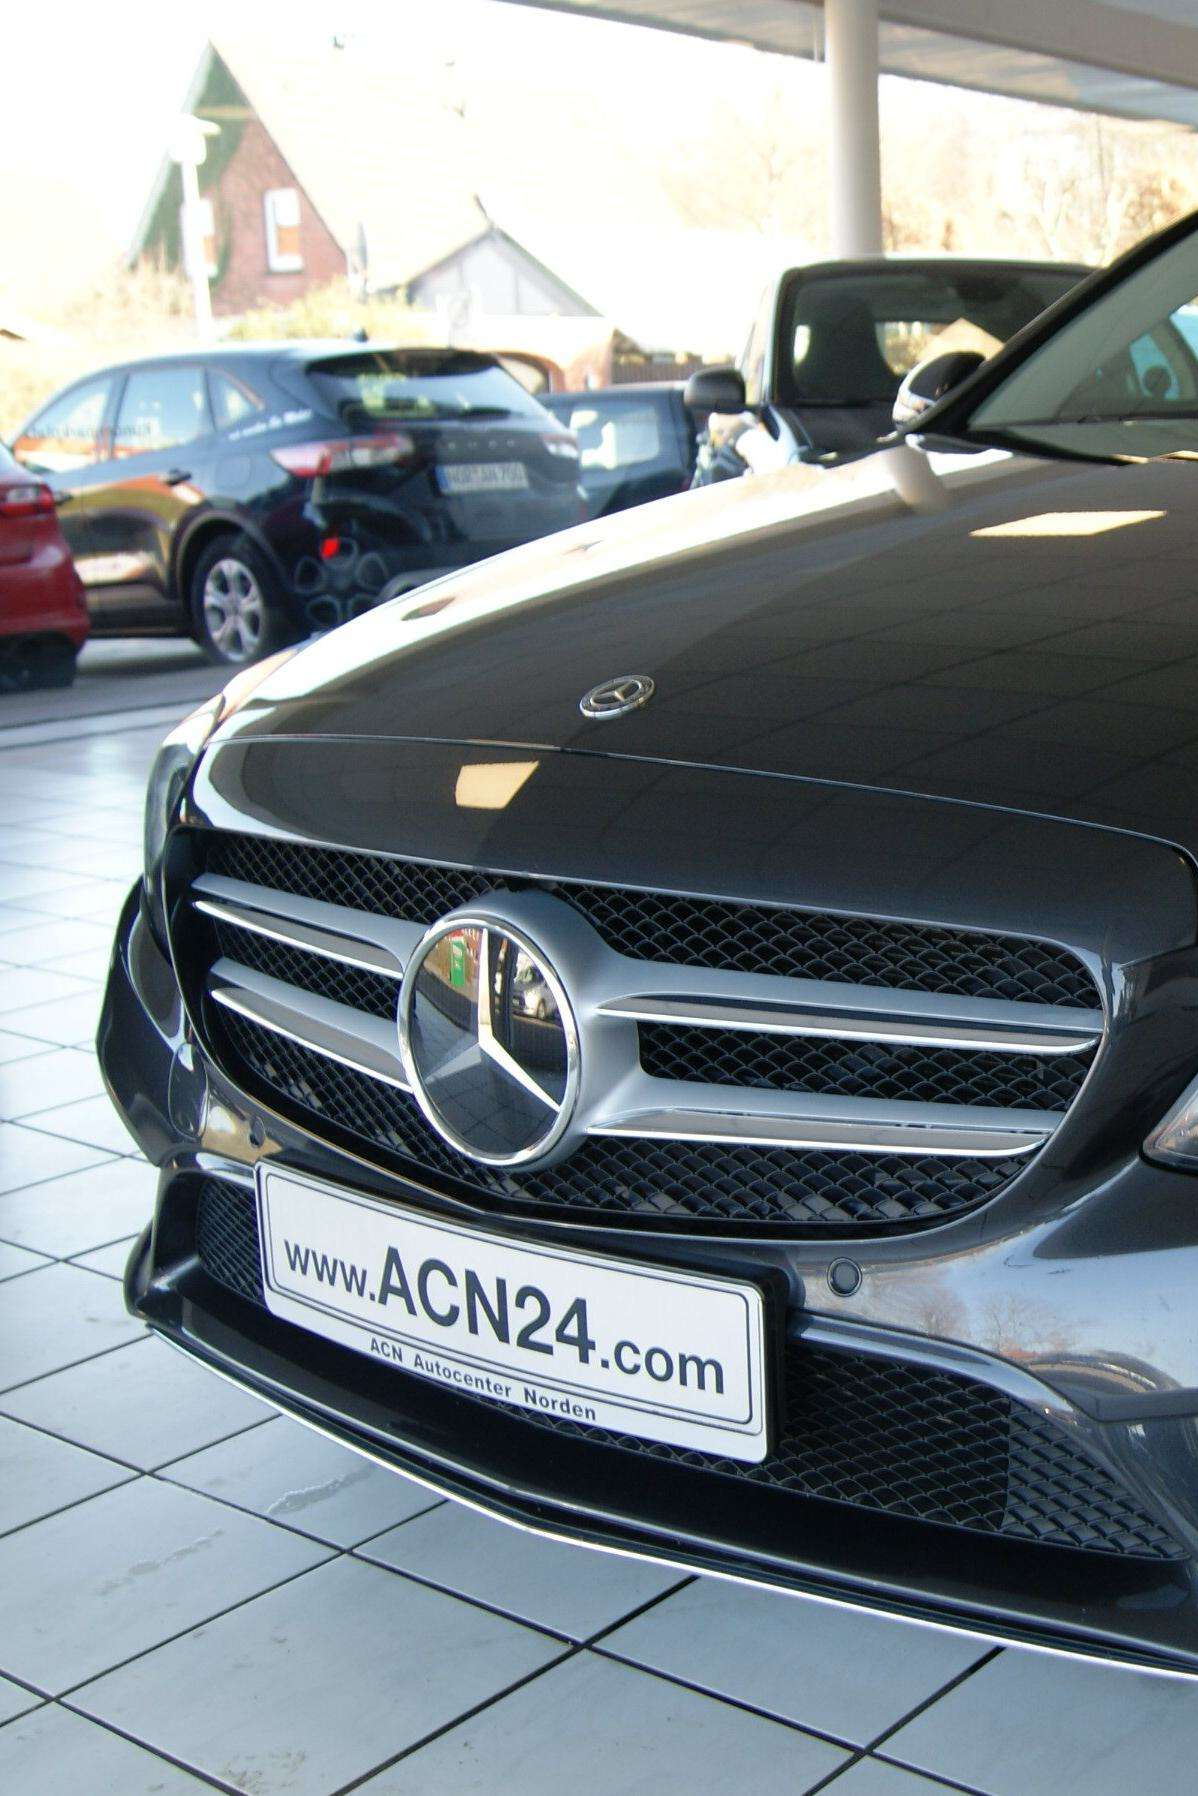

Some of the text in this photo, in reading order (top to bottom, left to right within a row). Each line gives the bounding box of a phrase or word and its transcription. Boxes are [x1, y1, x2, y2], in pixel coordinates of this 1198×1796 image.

[284, 1240, 724, 1394] www.ACN24.com
[370, 1338, 597, 1421] ACN Autocenter Norden
